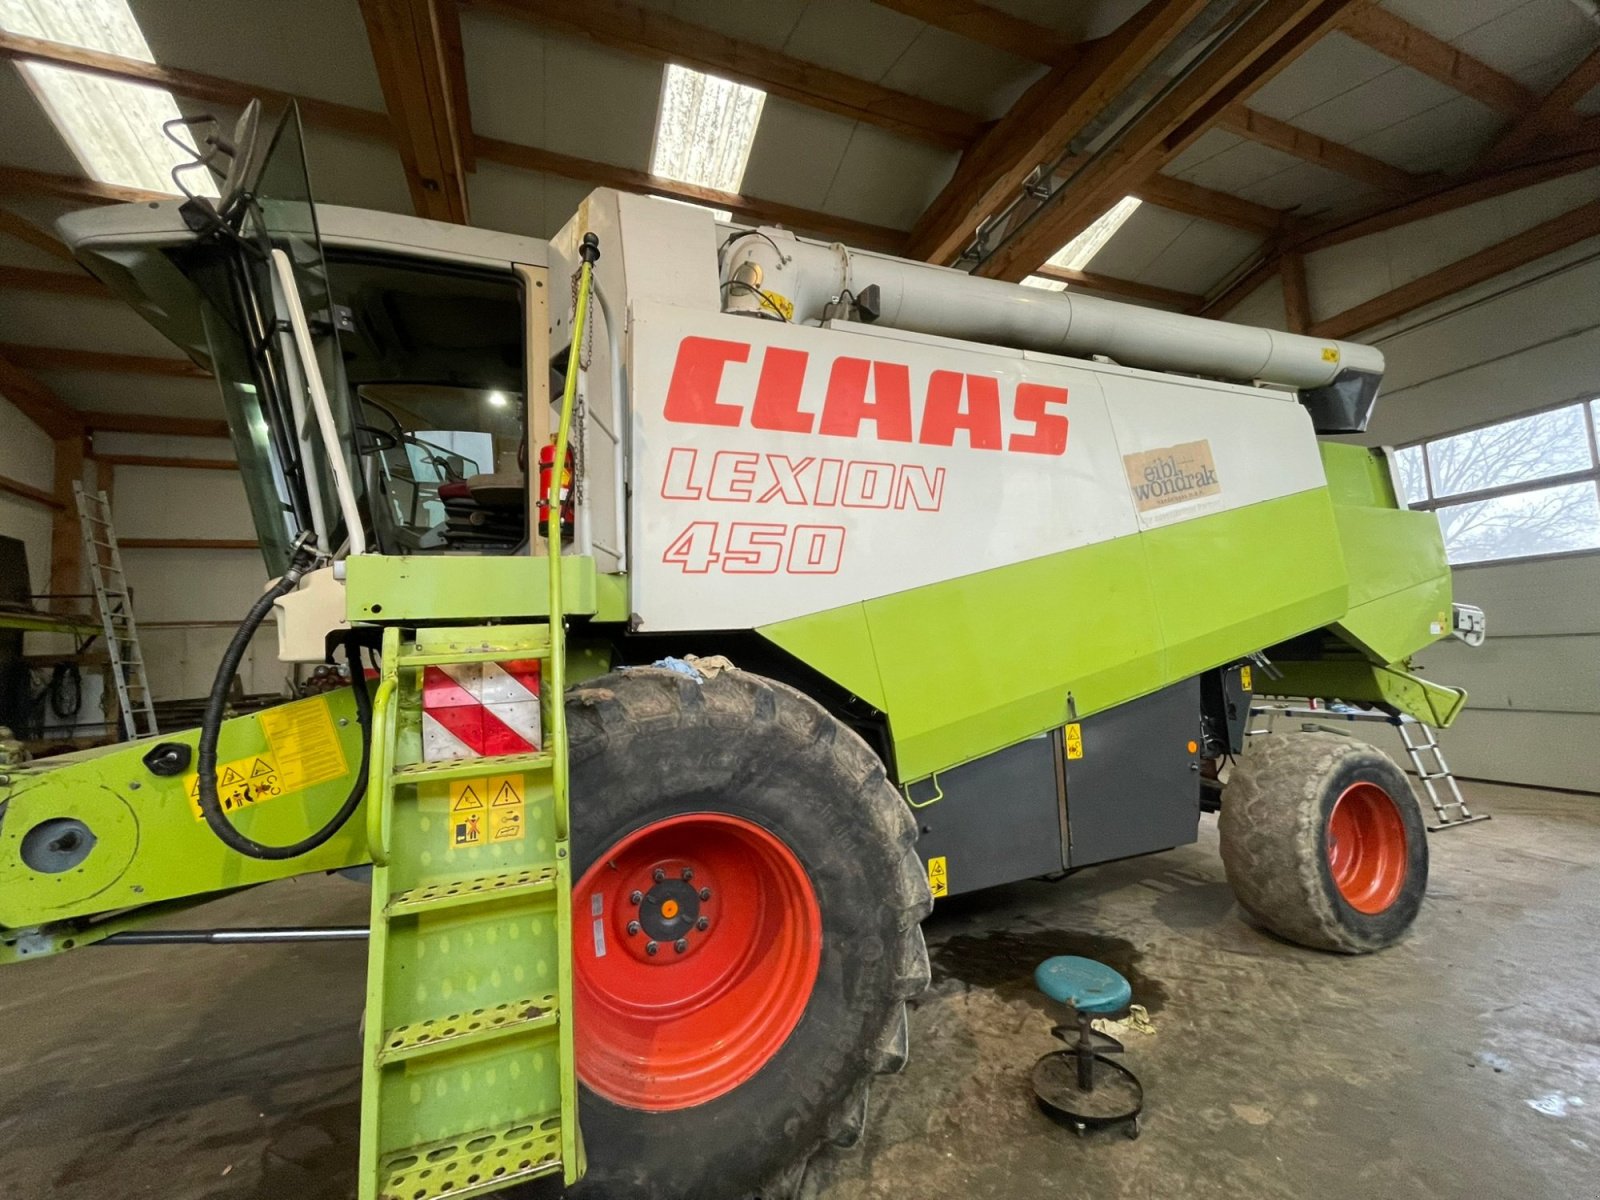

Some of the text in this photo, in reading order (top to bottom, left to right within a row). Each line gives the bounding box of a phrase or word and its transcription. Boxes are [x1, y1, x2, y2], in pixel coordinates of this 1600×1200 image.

[663, 336, 1069, 456] CLAAS
[661, 448, 946, 512] LEXION
[1134, 465, 1218, 500] wondrak
[1144, 456, 1178, 482] eibl
[662, 521, 846, 576] 450
